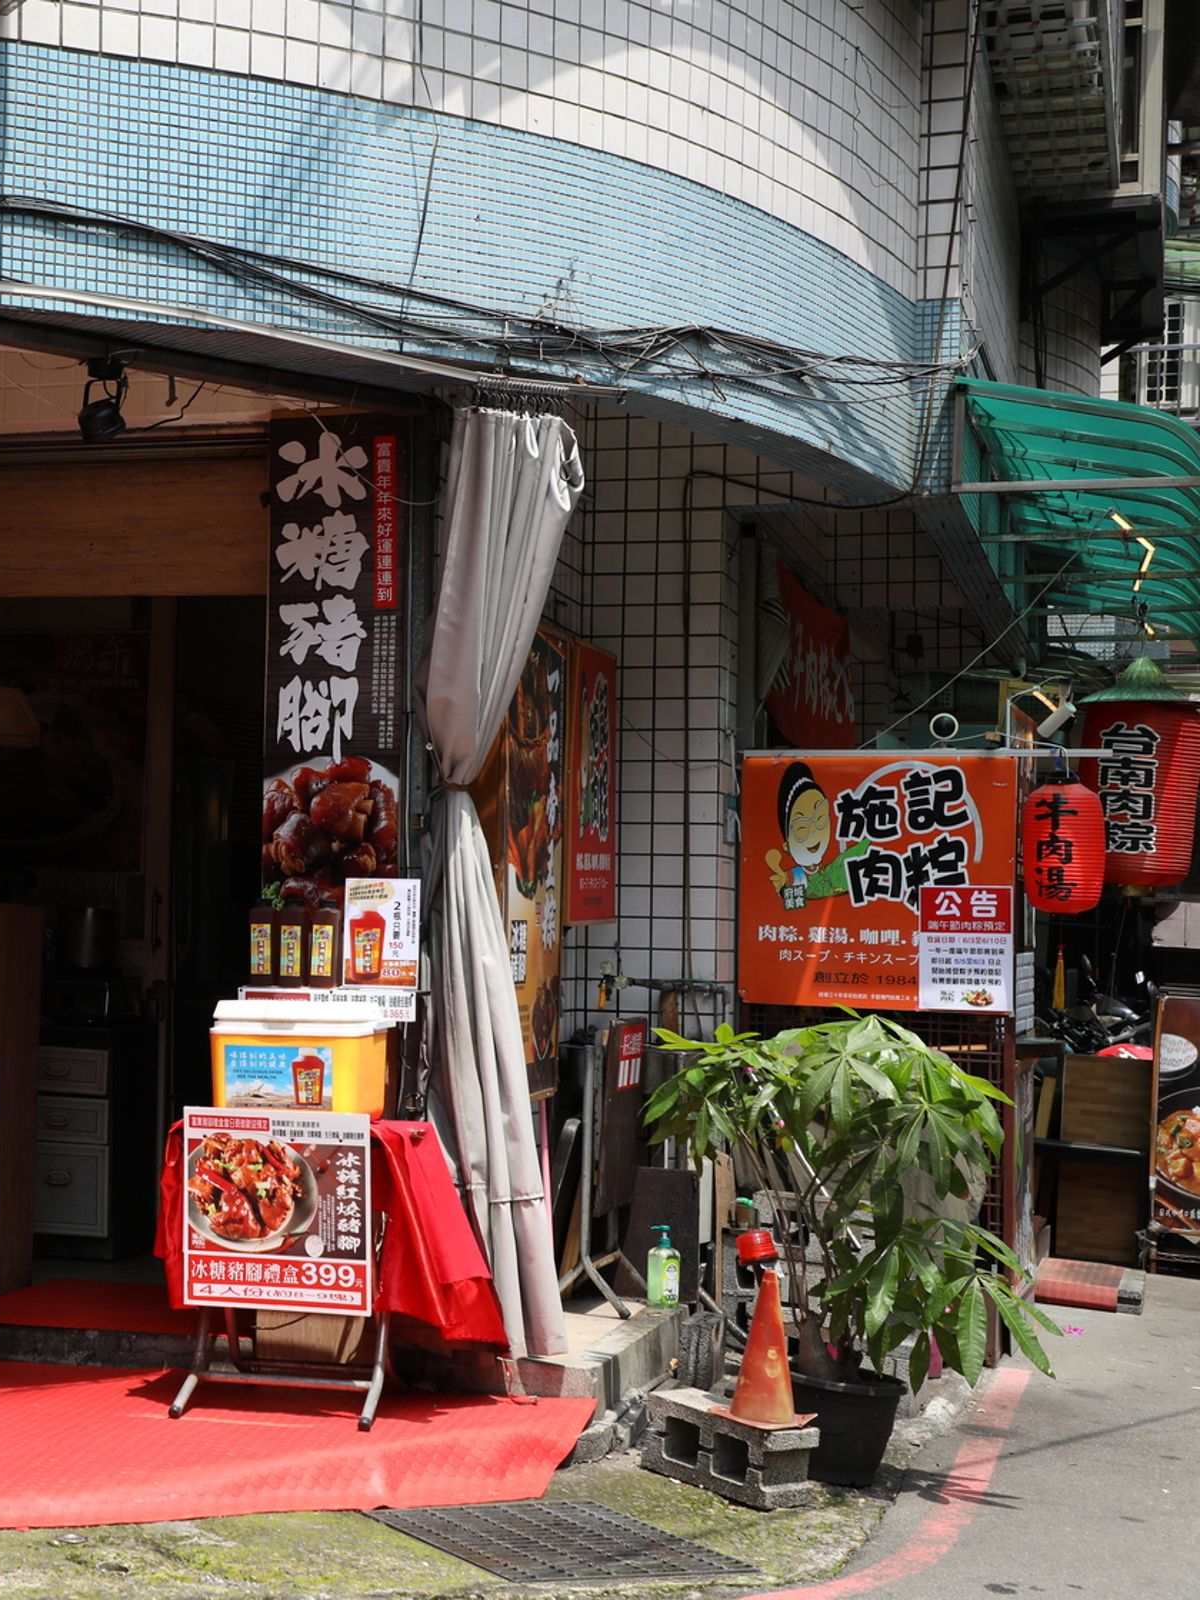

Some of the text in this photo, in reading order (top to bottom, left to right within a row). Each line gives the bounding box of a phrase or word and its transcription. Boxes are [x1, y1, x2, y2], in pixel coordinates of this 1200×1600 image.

[376, 441, 393, 603] 富貴年年來好運連連到
[275, 431, 371, 765] 冰糖豬腳
[836, 769, 971, 840] 施記
[1035, 793, 1079, 901] 牛肉湯
[935, 891, 998, 918] 公告
[813, 971, 917, 986] 創立於 1984
[191, 1259, 299, 1285] 冰糖豬腳禮盒
